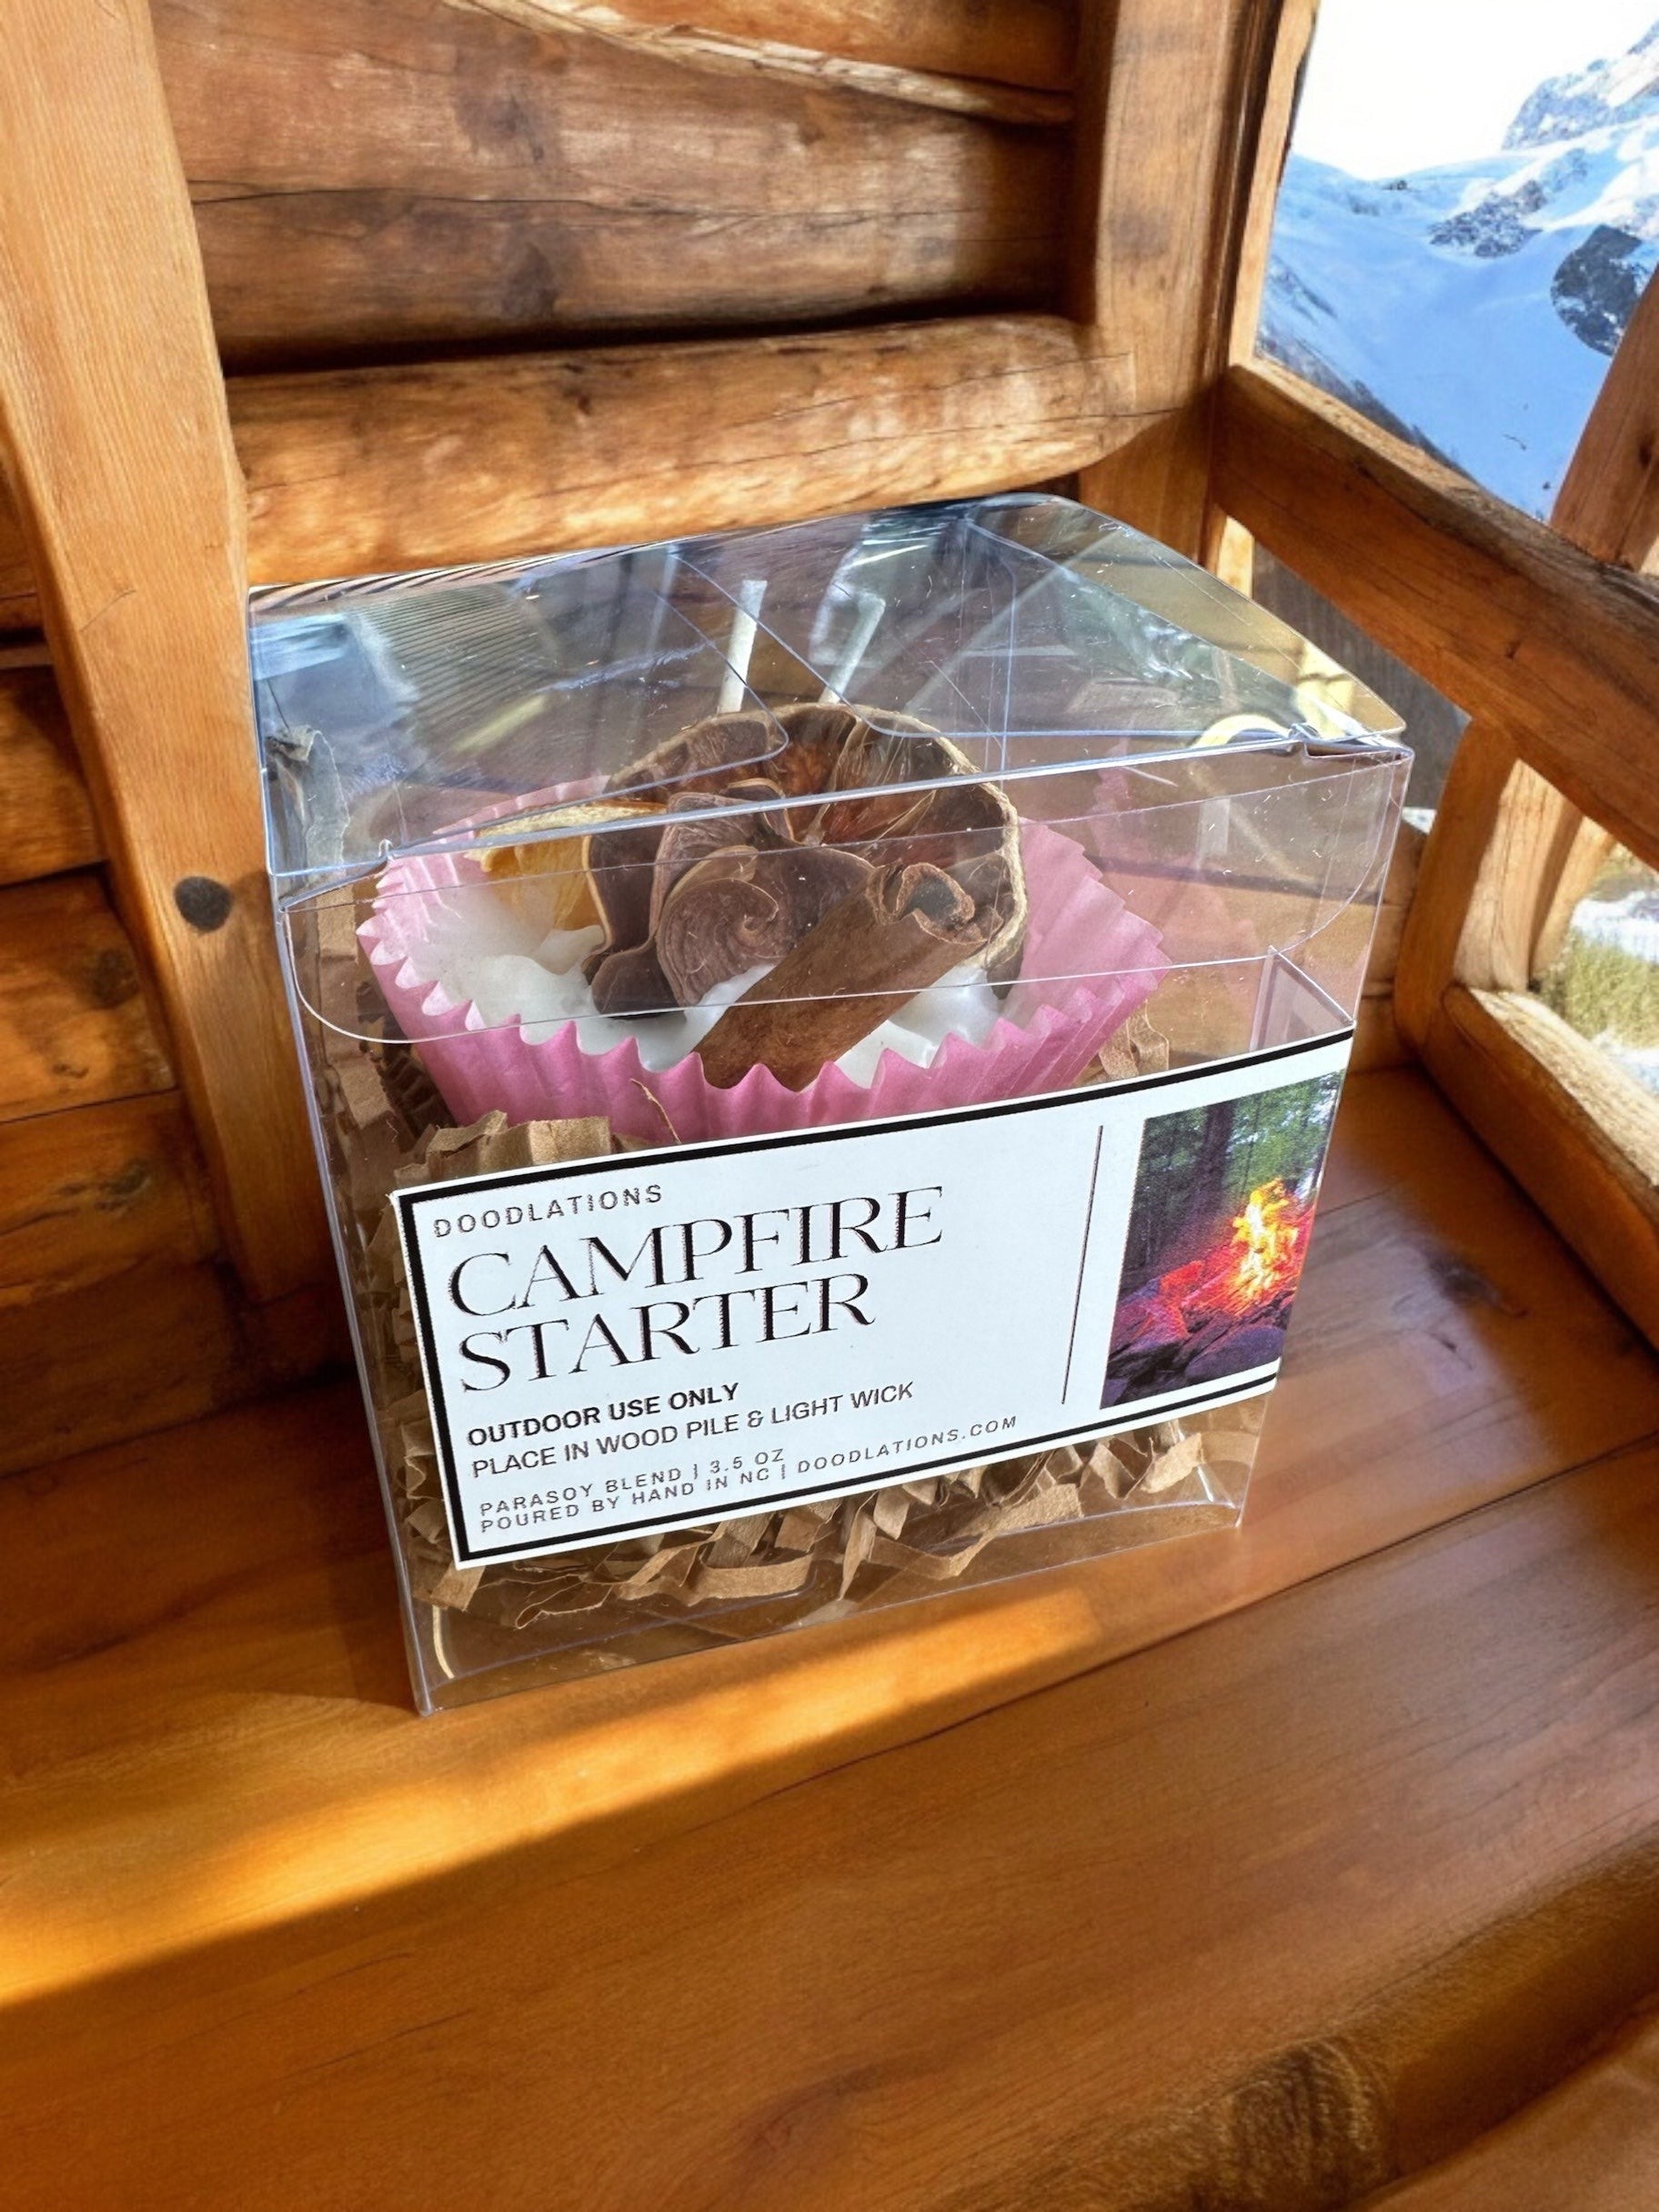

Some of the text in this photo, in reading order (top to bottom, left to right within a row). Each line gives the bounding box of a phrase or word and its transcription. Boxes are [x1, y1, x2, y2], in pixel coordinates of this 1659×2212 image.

[434, 1184, 663, 1239] DOODLATIONS
[447, 1186, 943, 1318] CAMPFIRE
[457, 1273, 877, 1393] STARTER
[467, 1382, 739, 1446] OUTDOOR USE ONLY
[472, 1382, 914, 1478] PLACE IN WOOD PILE & LIGHT WICK
[480, 1483, 594, 1516] PARASOY
[606, 1467, 682, 1493] BLEND
[710, 1455, 744, 1474] 3.5
[754, 1448, 785, 1465] OZ
[481, 1503, 579, 1533] POURED
[592, 1496, 619, 1513] BY
[632, 1483, 695, 1505] HAND
[707, 1475, 728, 1491] IN
[739, 1467, 770, 1484] NC
[797, 1415, 1018, 1474] DOODLATIONS.COM
